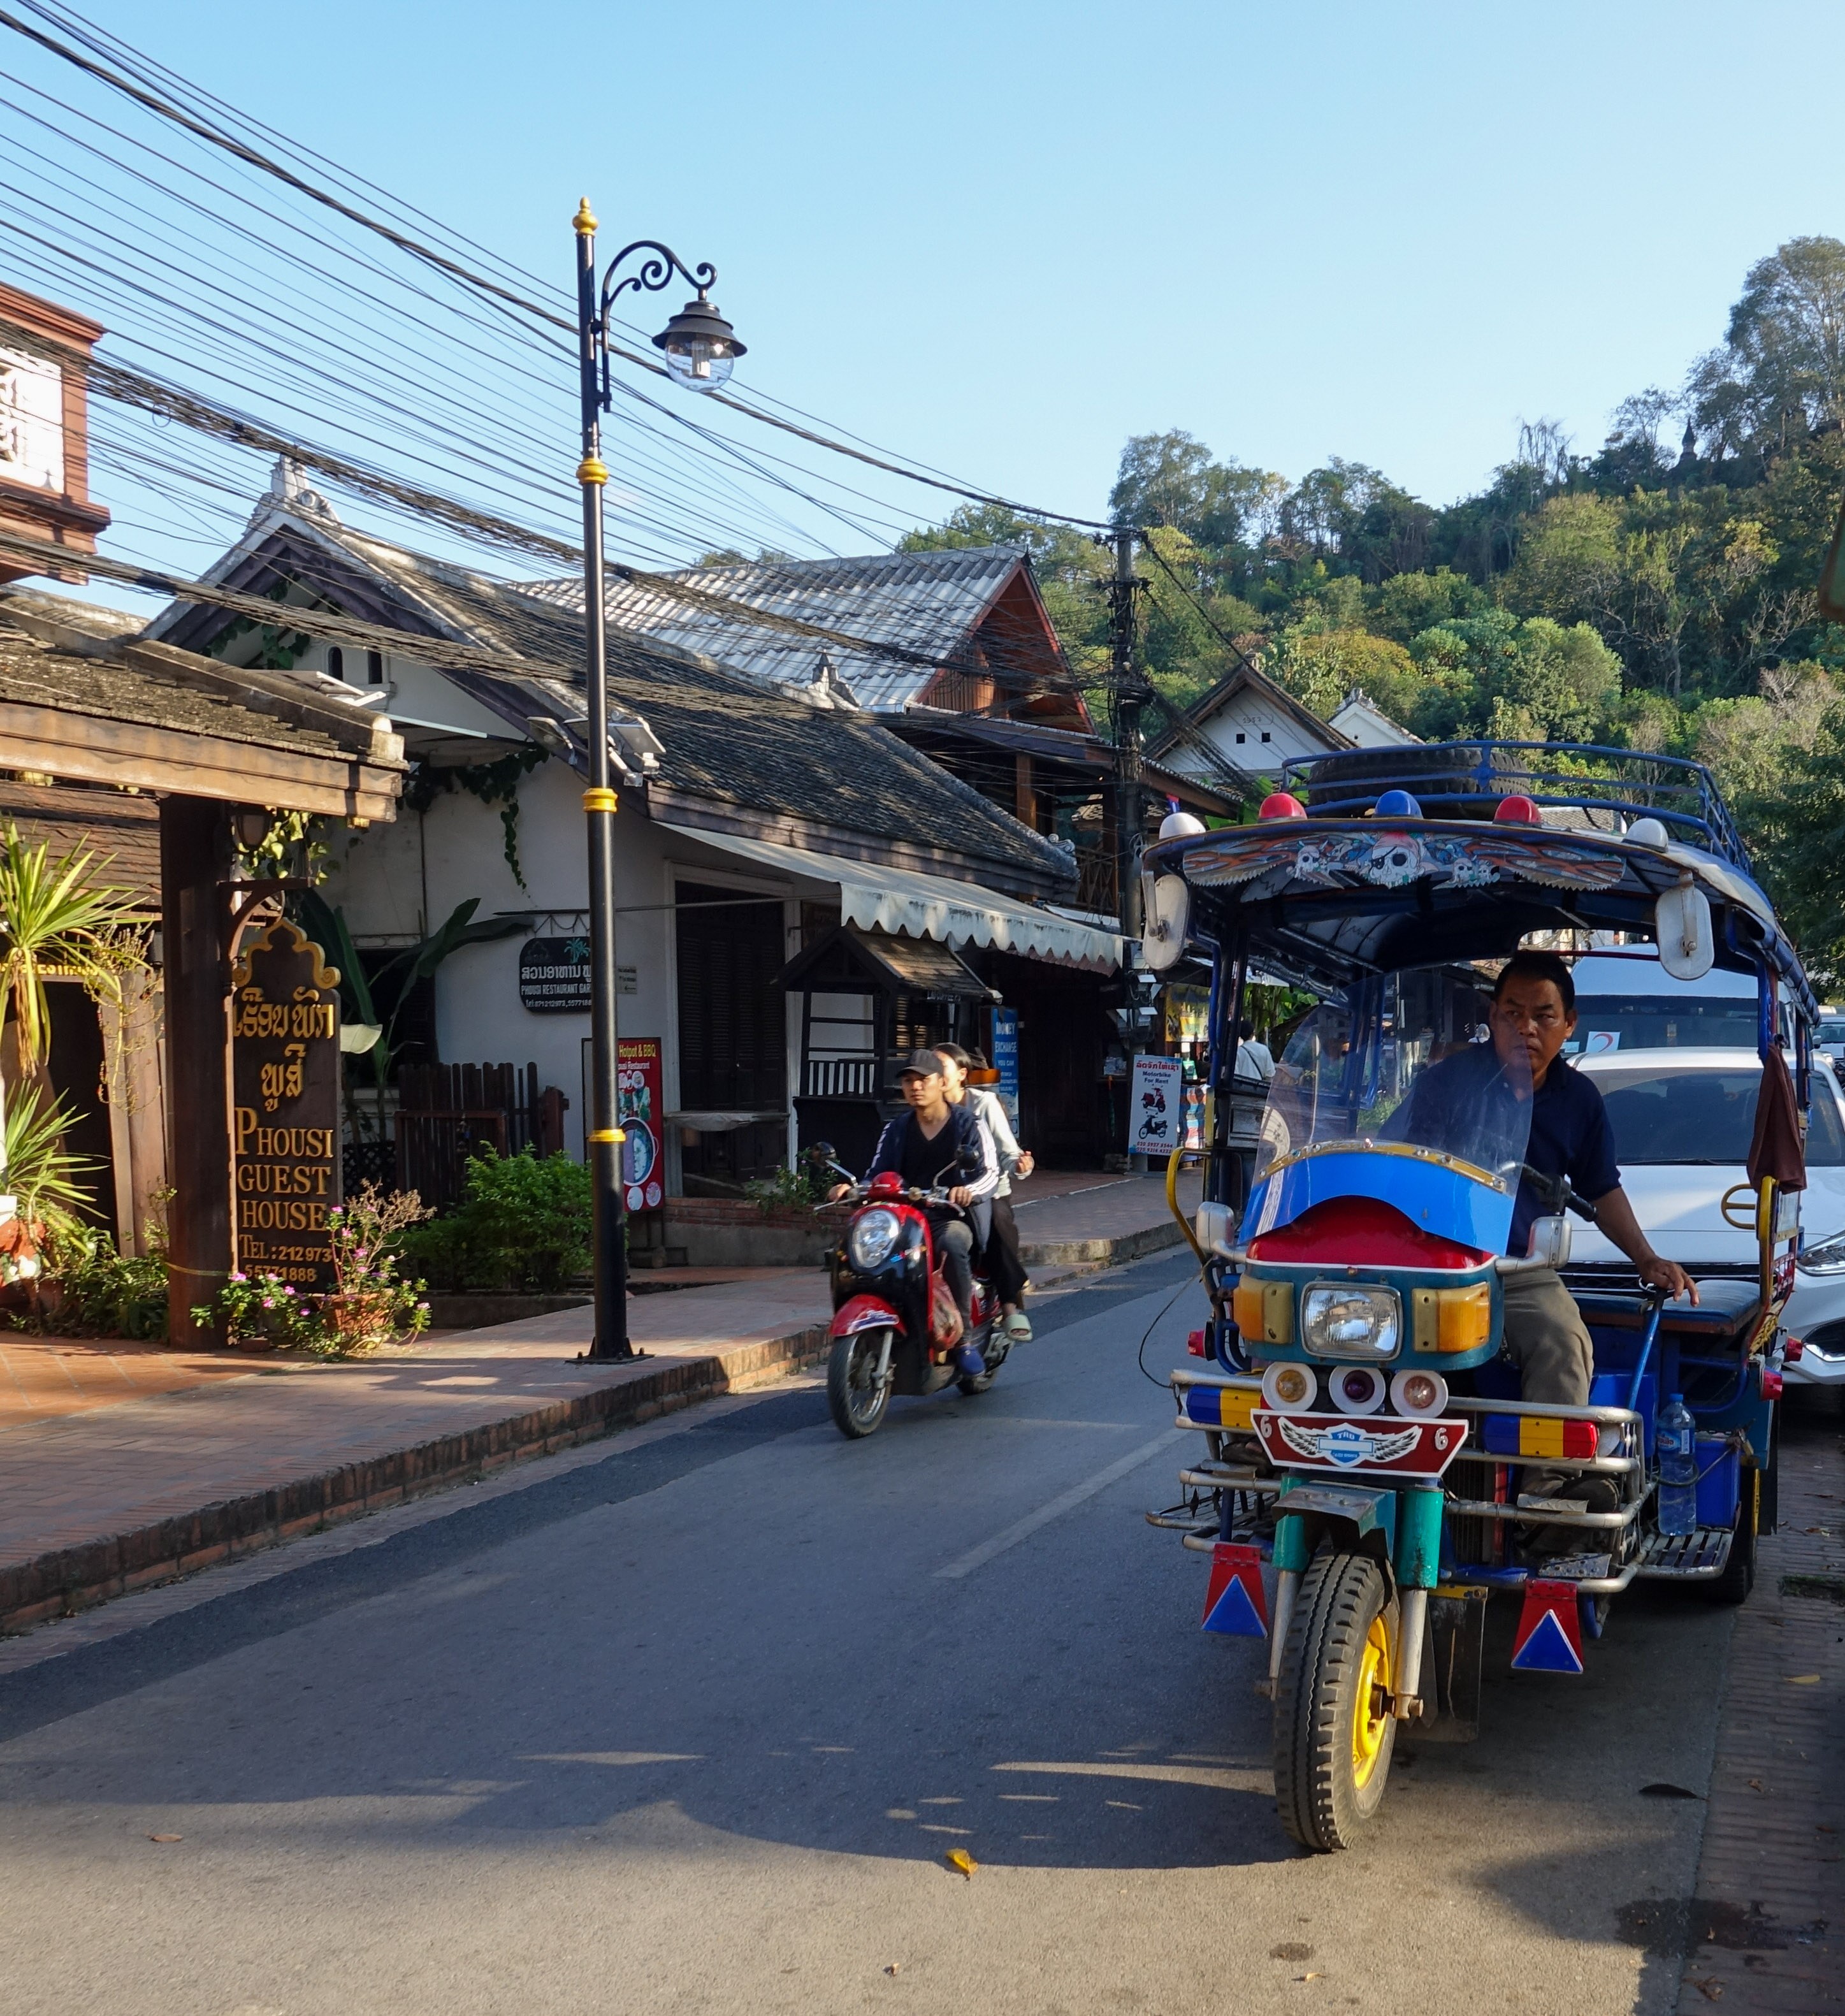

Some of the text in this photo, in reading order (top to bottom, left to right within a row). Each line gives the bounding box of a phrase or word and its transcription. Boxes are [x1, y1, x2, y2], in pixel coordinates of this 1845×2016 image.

[542, 983, 578, 994] RESTAURANT
[995, 1021, 1015, 1034] MONEY
[619, 1044, 656, 1060] Hotpot & BBQ
[995, 1041, 1017, 1053] EXCHANGE
[235, 1107, 334, 1158] PHOUSI
[238, 1164, 331, 1195] GUEST
[241, 1200, 328, 1231] HOUSE
[1260, 1416, 1273, 1438] 6
[1435, 1427, 1449, 1450] 6
